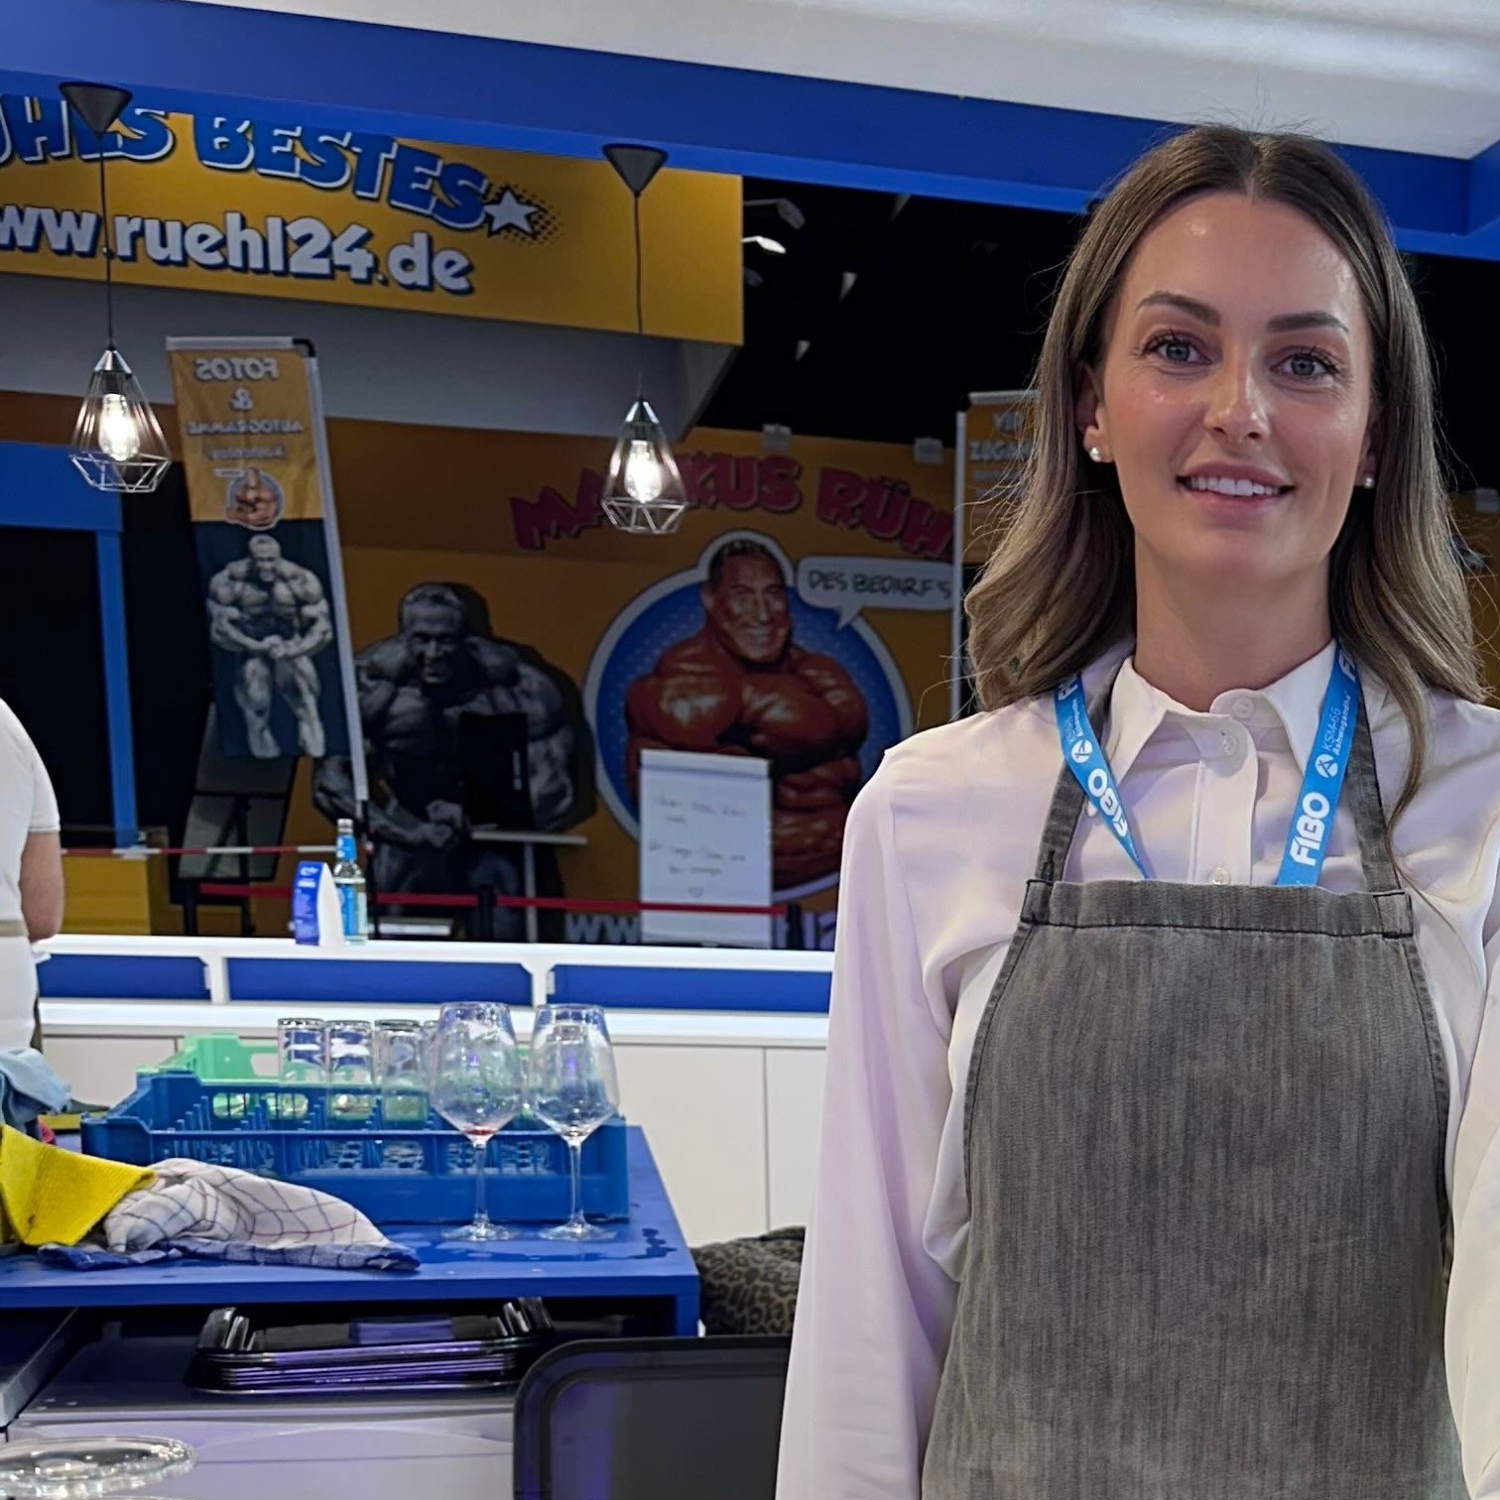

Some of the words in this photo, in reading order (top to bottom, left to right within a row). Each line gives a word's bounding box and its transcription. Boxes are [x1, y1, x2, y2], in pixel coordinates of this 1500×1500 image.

[193, 113, 490, 229] BESTES
[511, 453, 802, 550] MAKUS
[816, 467, 953, 562] RÜH
[807, 571, 847, 592] DES
[1088, 768, 1128, 837] FIBO
[1290, 792, 1330, 867] FIBO
